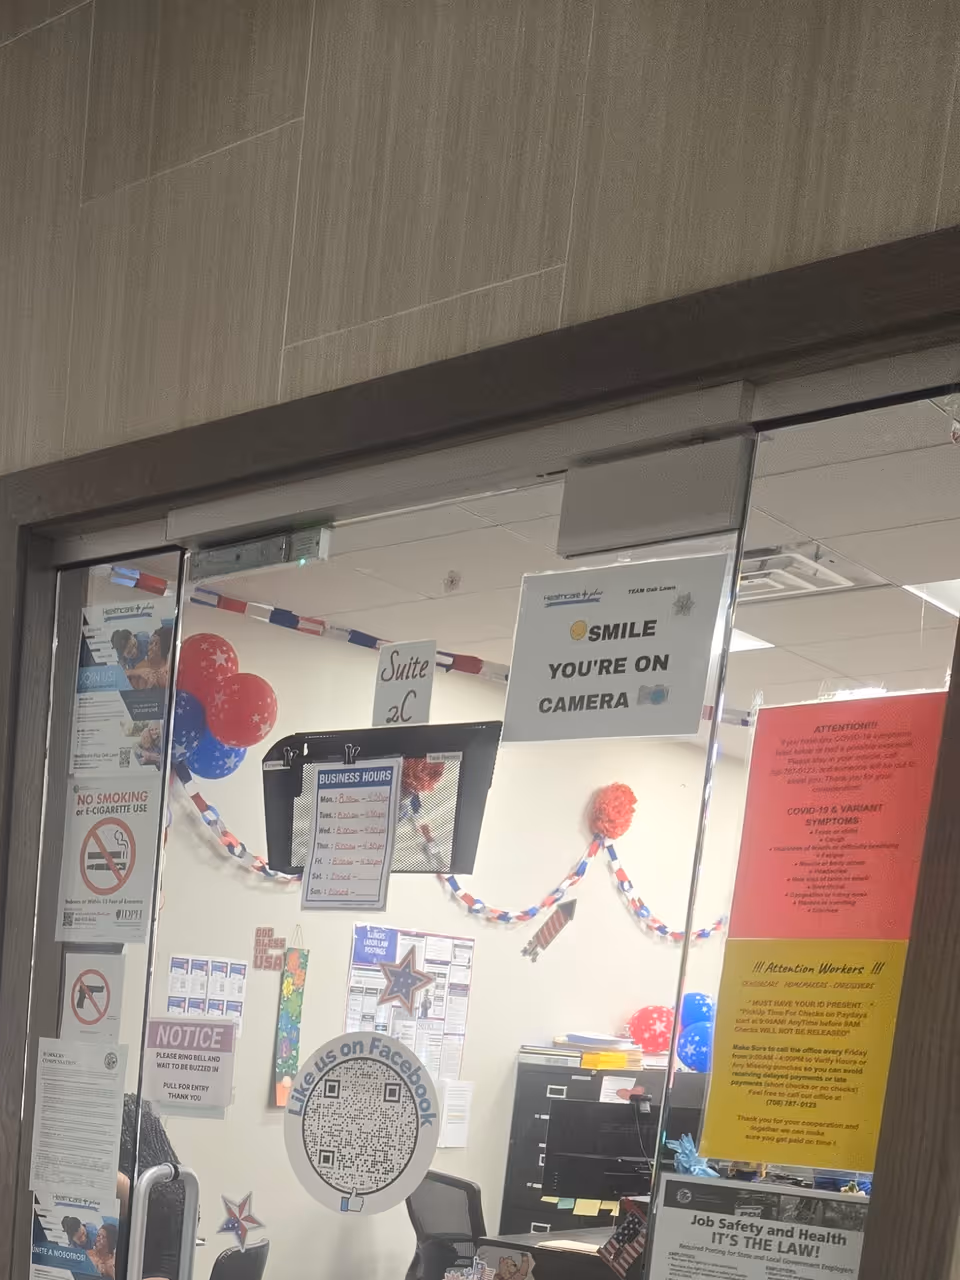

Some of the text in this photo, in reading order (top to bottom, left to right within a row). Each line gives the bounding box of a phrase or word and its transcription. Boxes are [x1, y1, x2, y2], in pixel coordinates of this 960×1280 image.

[588, 620, 657, 642] SMILE
[381, 650, 429, 682] Suite
[548, 654, 669, 680] YOU'RE ON
[386, 690, 417, 724] 2C
[539, 692, 629, 714] CAMERA
[320, 770, 391, 784] BUSINESS HOURS
[77, 791, 149, 805] NO SMOKING
[76, 804, 147, 816] or E-CIGARETTE USE
[788, 807, 829, 816] COVID-19
[841, 804, 883, 813] VARIANT
[806, 817, 859, 826] SYMPTOMS
[121, 909, 142, 920] IDPH
[256, 938, 285, 948] BLESS
[365, 947, 386, 955] POSTINGS
[253, 956, 283, 970] USA
[765, 962, 865, 974] Attention Workers
[156, 1025, 224, 1048] NOTICE
[156, 1052, 177, 1060] PLEASE
[844, 1048, 867, 1057] Friday
[288, 1037, 437, 1128] Like us on Facebook
[691, 1215, 847, 1246] Job Safety and Health
[712, 1232, 820, 1258] IT'S THE LAW!
[54, 1250, 86, 1262] NOSOTROS!
[679, 1243, 704, 1252] Required
[705, 1246, 726, 1256] Posting
[737, 1252, 752, 1260] State
[753, 1254, 765, 1262] and
[766, 1255, 781, 1263] Local
[783, 1258, 820, 1270] Government
[822, 1264, 854, 1274] Employers
